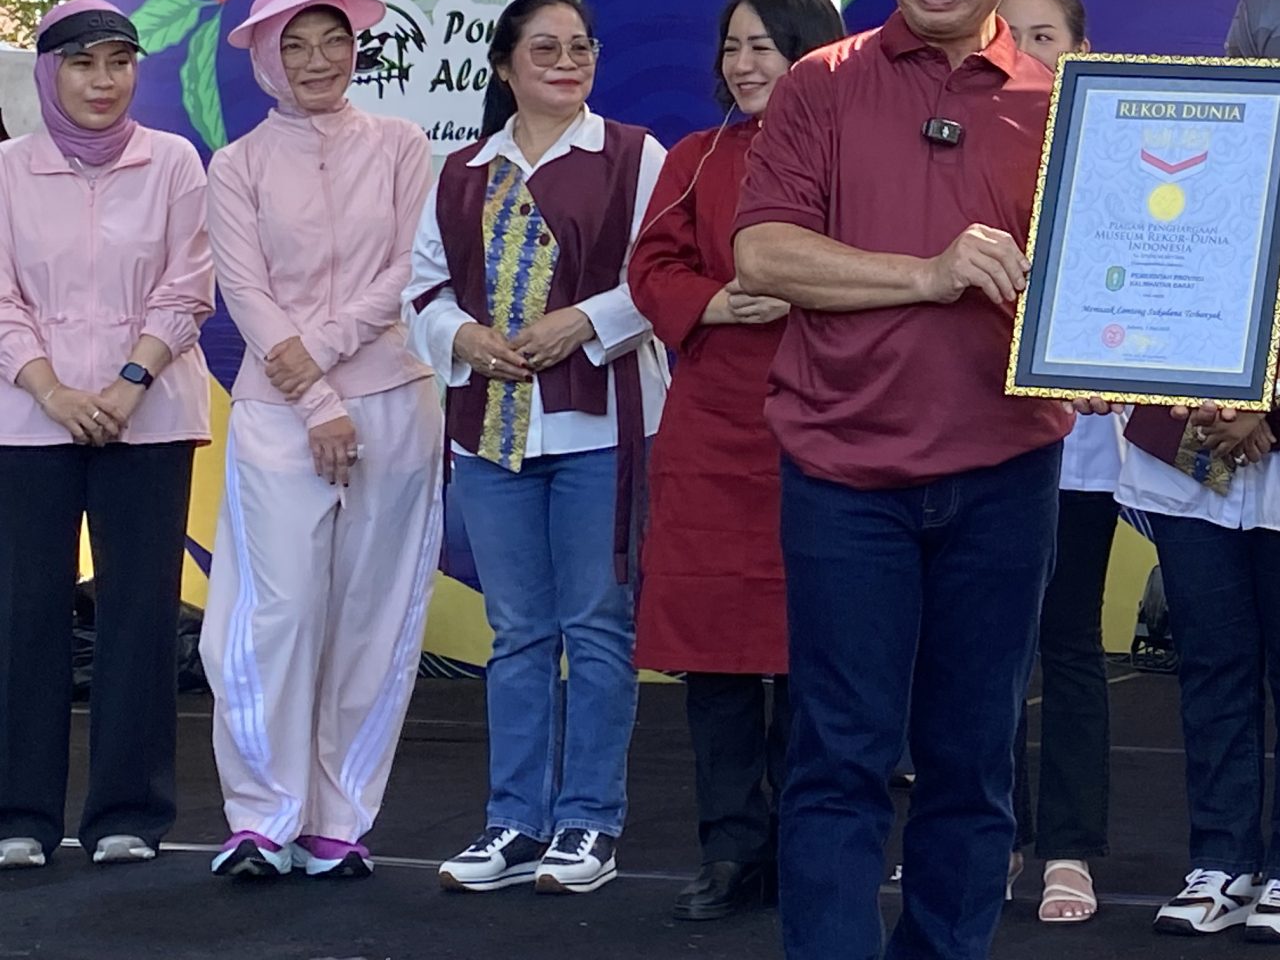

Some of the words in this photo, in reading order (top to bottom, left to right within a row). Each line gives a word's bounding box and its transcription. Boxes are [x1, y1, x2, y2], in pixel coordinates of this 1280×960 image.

[1119, 102, 1178, 118] REKOR
[1182, 104, 1241, 120] DUNIA
[1094, 230, 1144, 241] MUSEUM
[1128, 240, 1192, 253] INDONESIA
